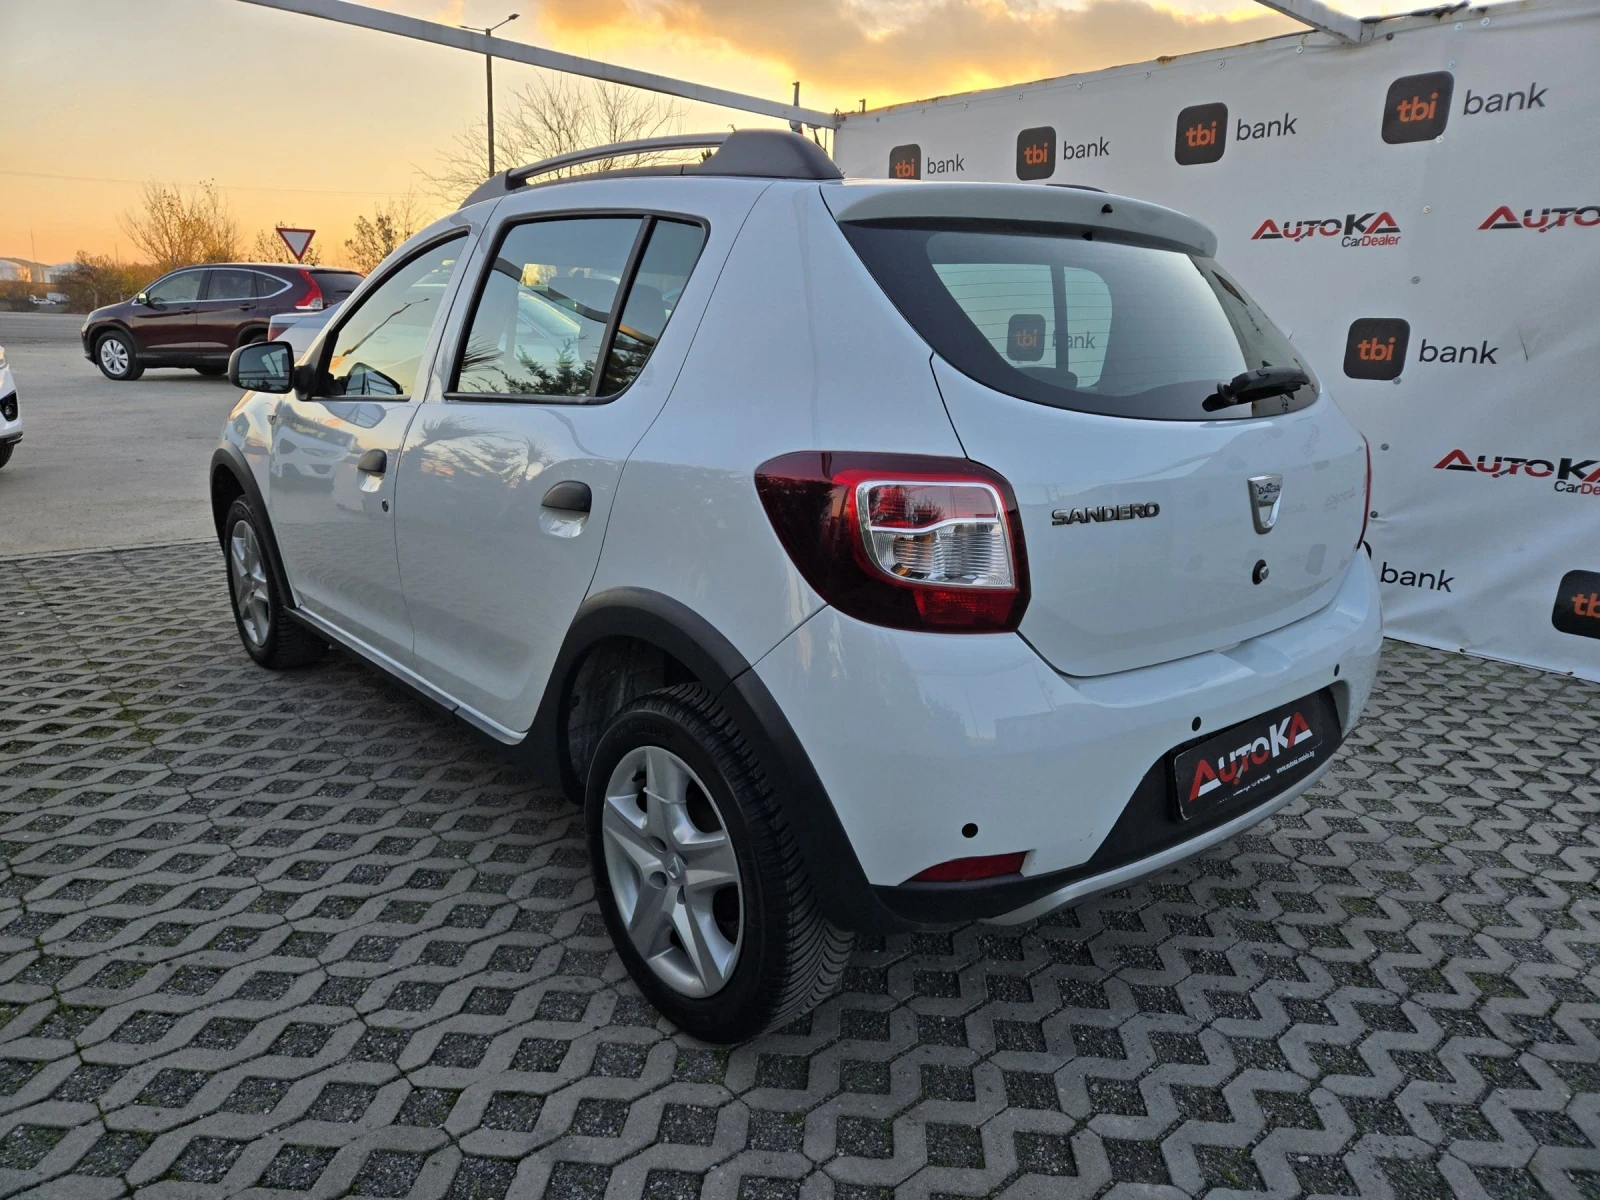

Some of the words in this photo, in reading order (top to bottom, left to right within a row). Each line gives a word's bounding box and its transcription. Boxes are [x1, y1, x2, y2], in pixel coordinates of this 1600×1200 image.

[1397, 92, 1438, 123] tbi
[1464, 82, 1548, 116] bank
[1185, 122, 1217, 147] tbi
[1236, 113, 1297, 142] bank
[1024, 145, 1048, 165] tbi
[1063, 136, 1110, 160] bank
[894, 161, 915, 179] tbi
[927, 154, 964, 175] bank
[1341, 234, 1401, 248] CarDealer
[1015, 328, 1038, 347] tbi
[1357, 337, 1396, 361] tbi
[1418, 339, 1499, 364] bank
[1052, 502, 1160, 526] SANDERO
[1380, 561, 1455, 593] bank
